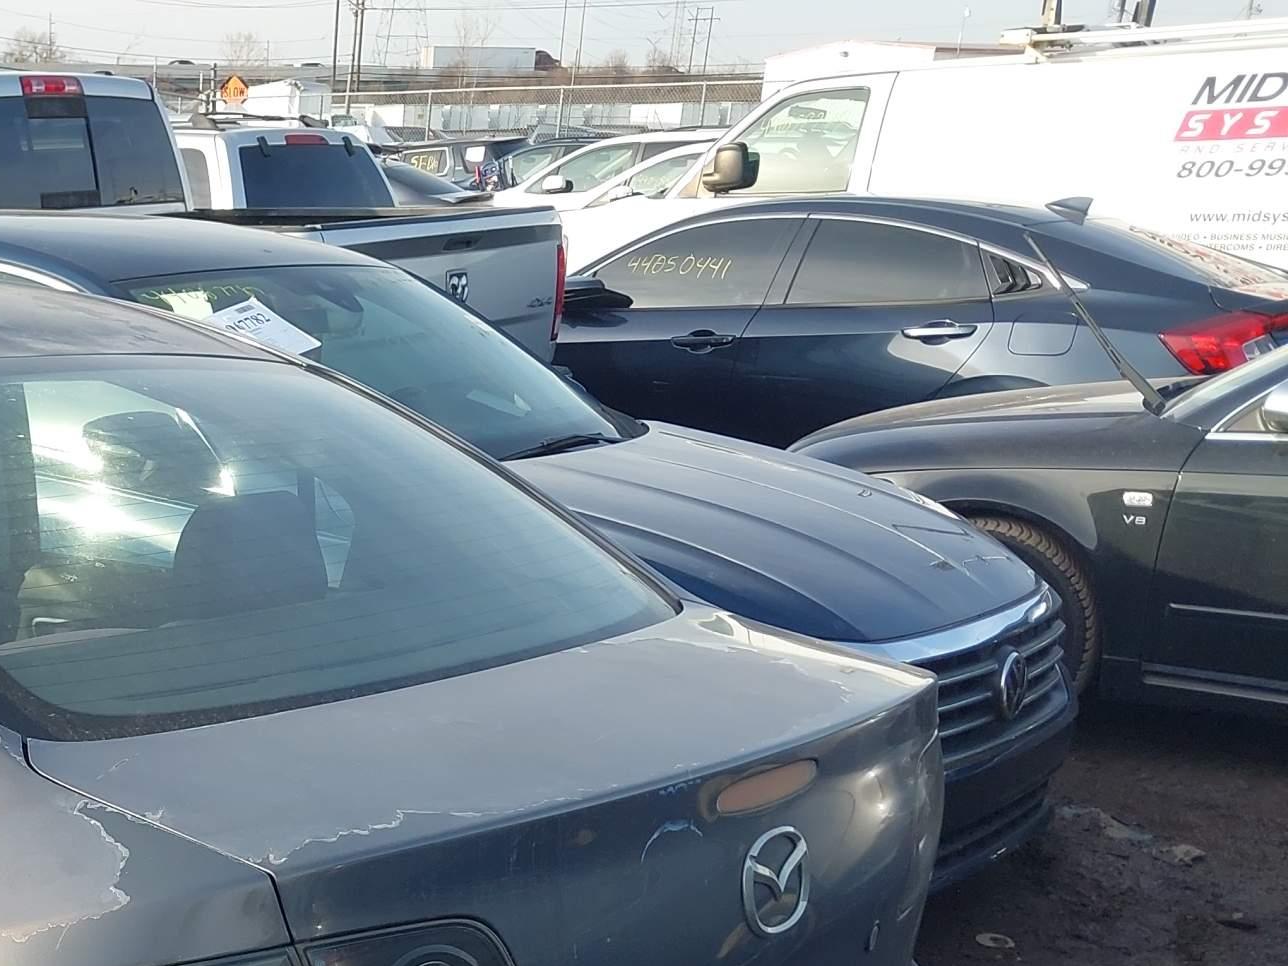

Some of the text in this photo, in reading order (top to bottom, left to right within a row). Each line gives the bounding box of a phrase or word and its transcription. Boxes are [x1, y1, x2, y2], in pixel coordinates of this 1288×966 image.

[223, 86, 246, 98] SLOW
[1190, 72, 1288, 106] MID
[1179, 110, 1281, 138] SYS
[1176, 158, 1288, 179] 800-99
[1122, 513, 1147, 525] V8
